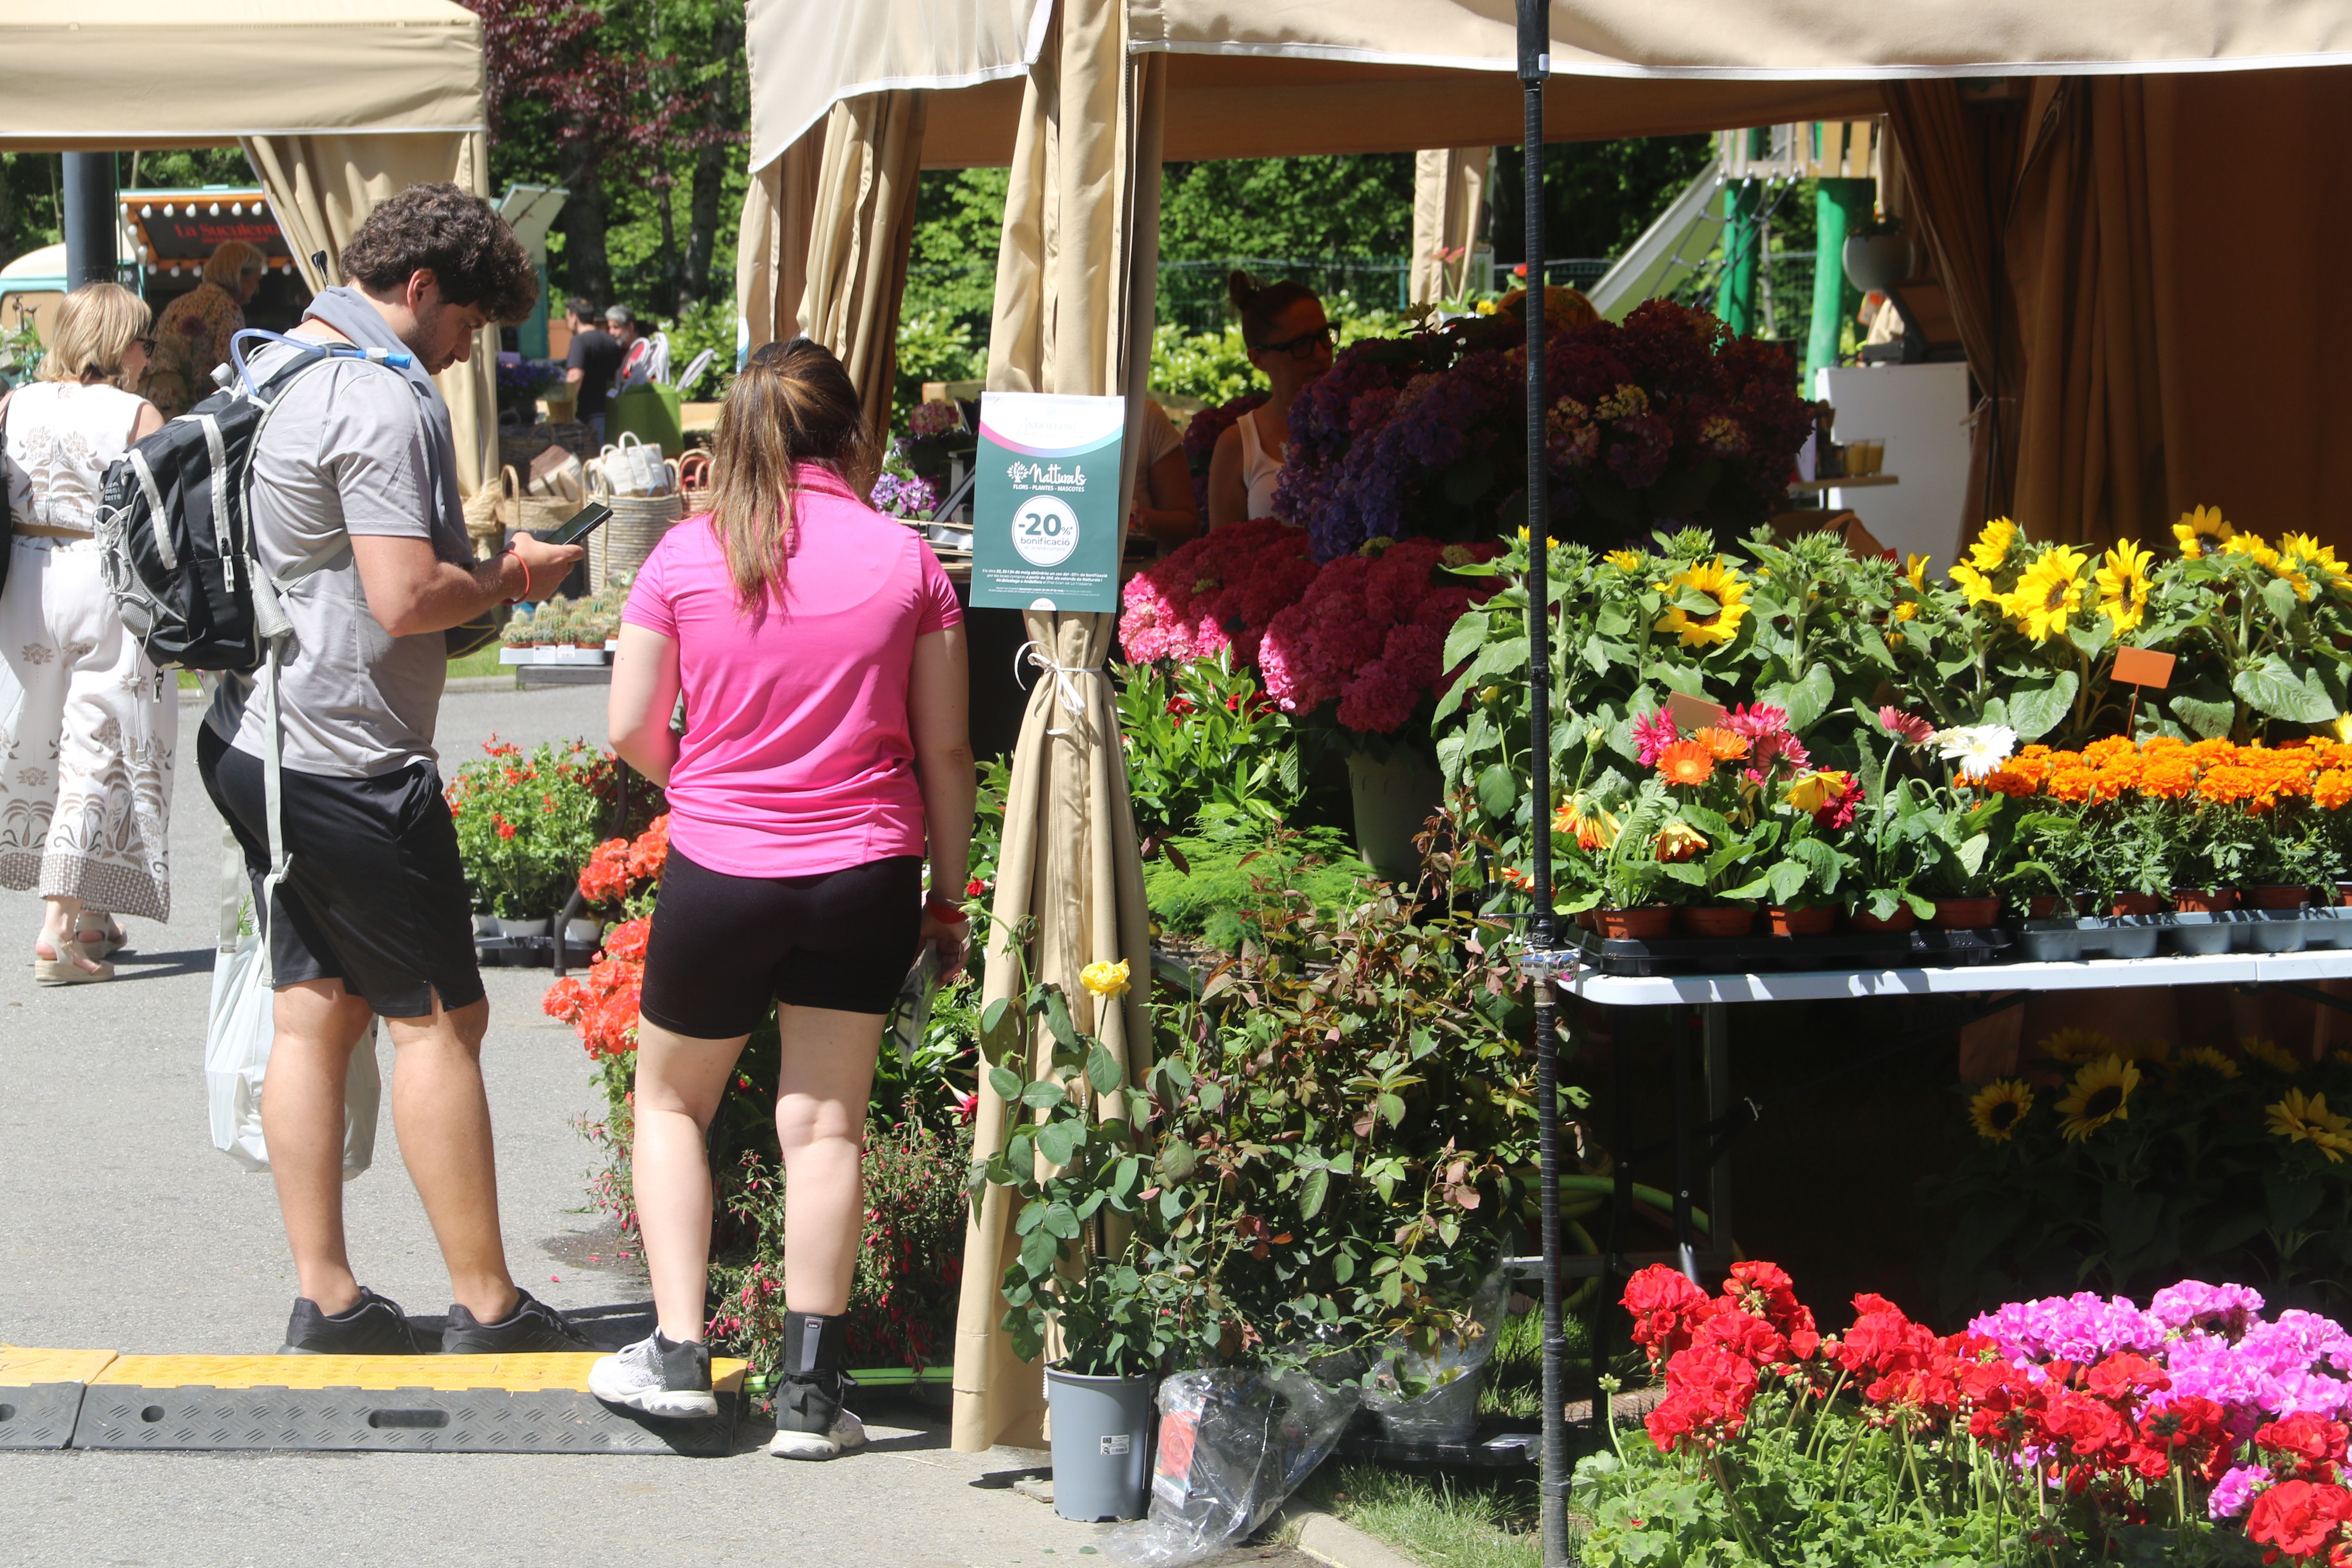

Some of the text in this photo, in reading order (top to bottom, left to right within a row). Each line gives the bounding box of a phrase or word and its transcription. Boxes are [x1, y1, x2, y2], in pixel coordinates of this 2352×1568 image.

[174, 224, 198, 237] La
[1029, 463, 1087, 486] Natturals
[1021, 537, 1070, 545] bonificació
